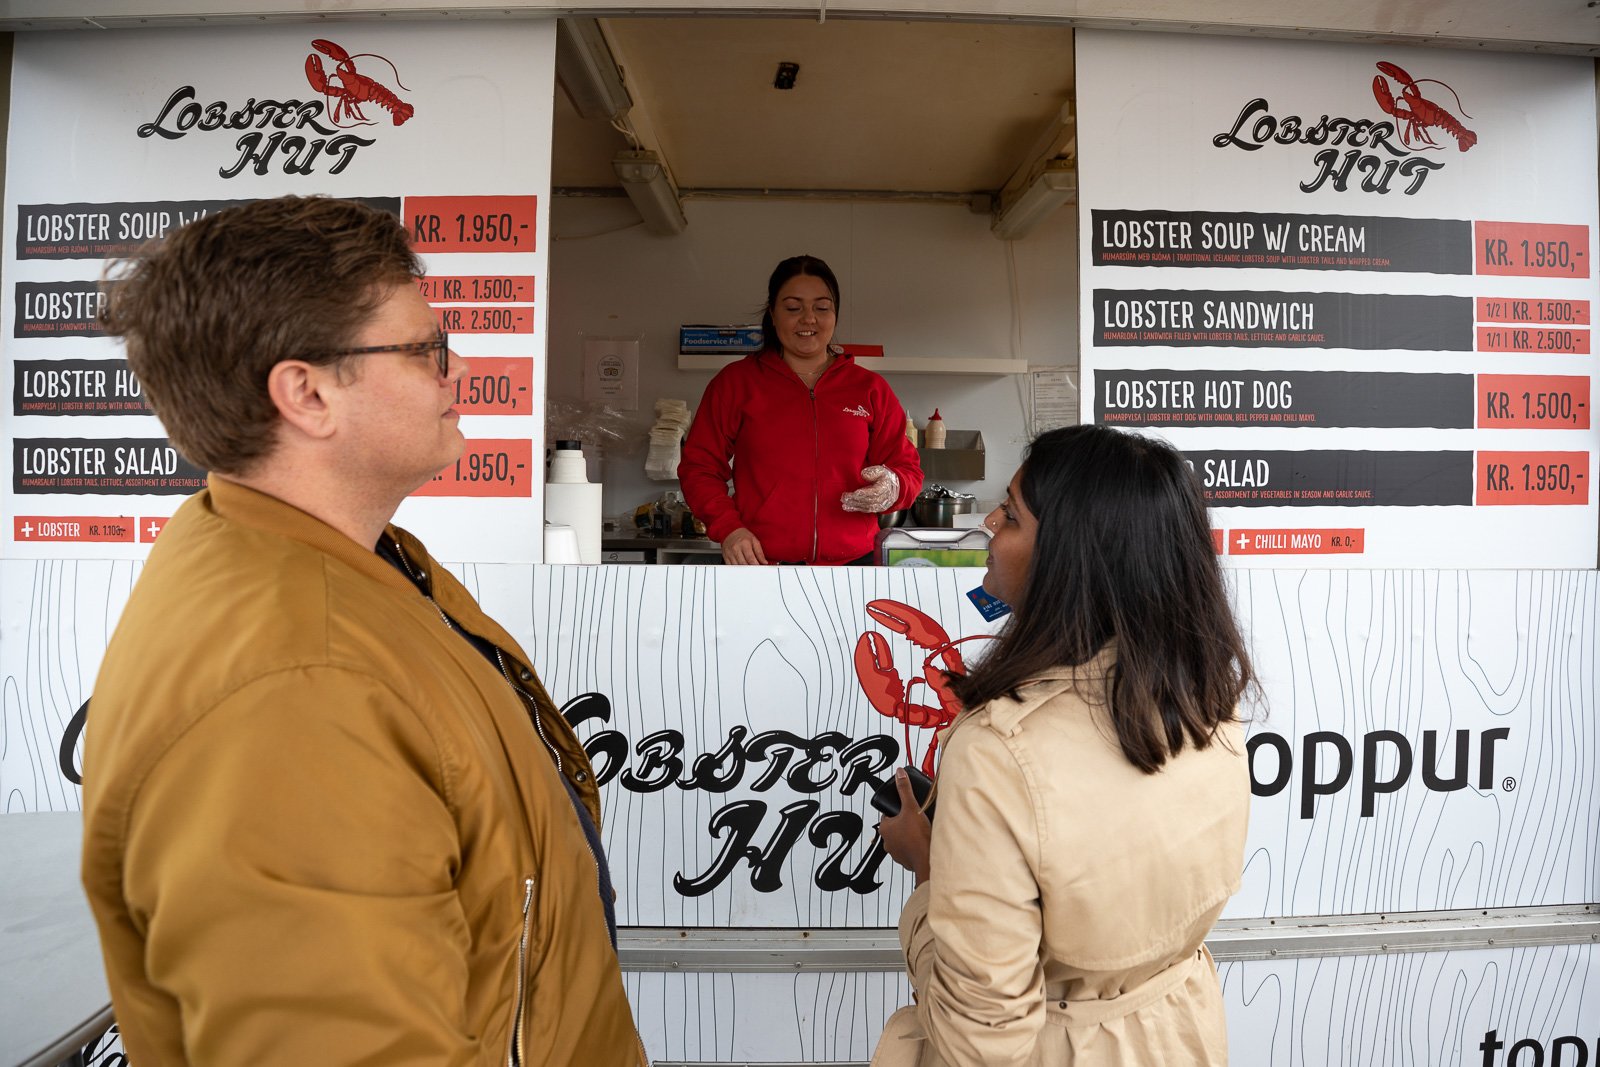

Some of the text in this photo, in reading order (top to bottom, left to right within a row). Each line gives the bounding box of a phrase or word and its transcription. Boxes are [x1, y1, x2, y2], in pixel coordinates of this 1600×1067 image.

[27, 213, 110, 242] LOBSTER
[119, 212, 170, 240] SOUP
[415, 214, 528, 246] KR. 1.950,-
[1102, 220, 1365, 253] LOBSTER SOUP W/ CREAM
[1176, 253, 1211, 262] TRADITIONAL
[1213, 254, 1240, 262] ICELANDIC
[1241, 254, 1264, 263] LOBSTER
[1266, 255, 1280, 263] SOUP
[1297, 256, 1320, 264] LOBSTER
[1321, 256, 1335, 264] TAILS
[1336, 257, 1347, 265] AND
[1349, 257, 1371, 265] WHIPPED
[1485, 239, 1583, 272] KR. 1.950,-
[443, 279, 466, 299] KR.
[472, 279, 523, 301] 1.500,-
[25, 292, 107, 320] LOBSTER
[1104, 300, 1314, 330] LOBSTER SANDWICH
[1513, 302, 1532, 320] KR.
[1537, 302, 1580, 324] 1.500,-
[60, 323, 87, 331] SANDWICH
[443, 309, 523, 333] KR. 2.500,-
[684, 337, 743, 345] Foodservice Foil
[1103, 332, 1138, 340] HUMARLOKA
[1143, 332, 1173, 340] SANDWICH
[1174, 332, 1191, 340] FILLED
[1251, 333, 1274, 341] LETTUCE
[1307, 334, 1325, 342] SAUCE.
[1513, 331, 1532, 349] KR.
[1538, 331, 1581, 352] 2.500,-
[23, 370, 142, 398] LOBSTER HO
[453, 375, 526, 408] 1.500,-
[1105, 380, 1195, 408] LOBSTER
[1204, 380, 1244, 408] HOT
[1253, 380, 1292, 409] DOG
[61, 402, 83, 410] LOBSTER
[84, 402, 94, 410] HOT
[96, 402, 107, 410] DOG
[109, 402, 123, 410] WITH
[1104, 413, 1141, 421] HUMARPYLSA
[1147, 413, 1171, 421] LOBSTER
[1172, 413, 1183, 421] HOT
[1184, 413, 1197, 421] DOG
[1198, 413, 1213, 421] WITH
[1236, 413, 1248, 422] BELL
[1250, 414, 1268, 422] PEPPER
[1270, 414, 1282, 422] AND
[1487, 392, 1585, 424] KR. 1.500,-
[23, 447, 177, 475] LOBSTER SALAD
[456, 453, 524, 486] 1.950,-
[1204, 459, 1270, 487] SALAD
[22, 478, 56, 487] HUMARSALAT
[61, 478, 82, 487] LOBSTER
[125, 478, 159, 487] ASSORTMENT
[160, 478, 167, 487] OF
[169, 478, 199, 487] VEGETABLES
[1487, 464, 1583, 495] KR. 1.950,-
[1215, 490, 1250, 499] ASSORTMENT
[1251, 490, 1258, 498] OF
[1260, 490, 1292, 498] VEGETABLES
[1294, 490, 1300, 498] IN
[1301, 490, 1321, 498] SEASON
[1323, 490, 1334, 498] AND
[1335, 490, 1353, 498] GARLIC
[38, 522, 80, 537] LOBSTER
[89, 525, 100, 536] KR.
[1255, 534, 1286, 549] CHILLI
[1291, 534, 1322, 549] MAYO
[1332, 537, 1342, 547] KR.
[1246, 727, 1510, 819] oppur
